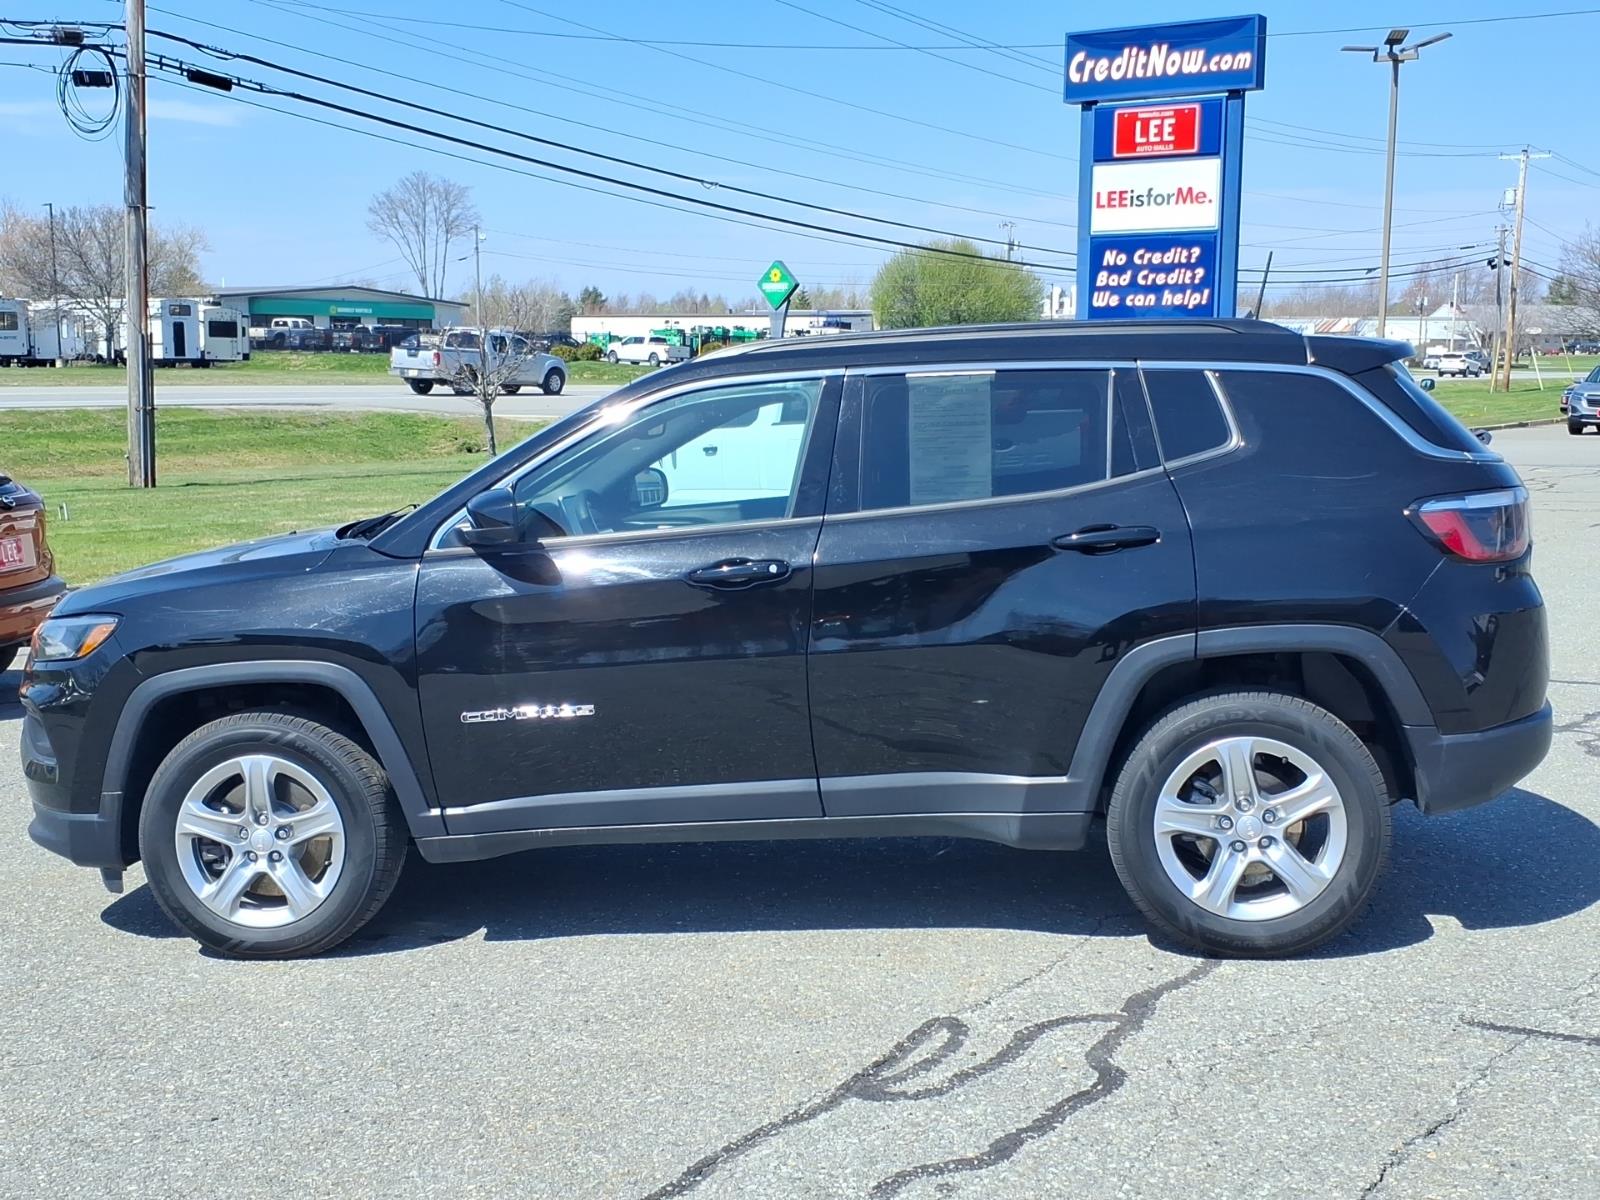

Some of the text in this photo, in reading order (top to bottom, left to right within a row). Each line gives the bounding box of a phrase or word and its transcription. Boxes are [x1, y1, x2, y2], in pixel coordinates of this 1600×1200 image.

[1069, 44, 1252, 84] CreditNow.com
[1135, 118, 1176, 143] LEE
[1096, 186, 1213, 210] LEEisforMe.
[1103, 246, 1201, 266] No Credit?
[1096, 267, 1205, 287] Bad Credit?
[1092, 288, 1210, 310] We can help!
[0, 543, 20, 563] LEE
[460, 703, 595, 724] COMASS
